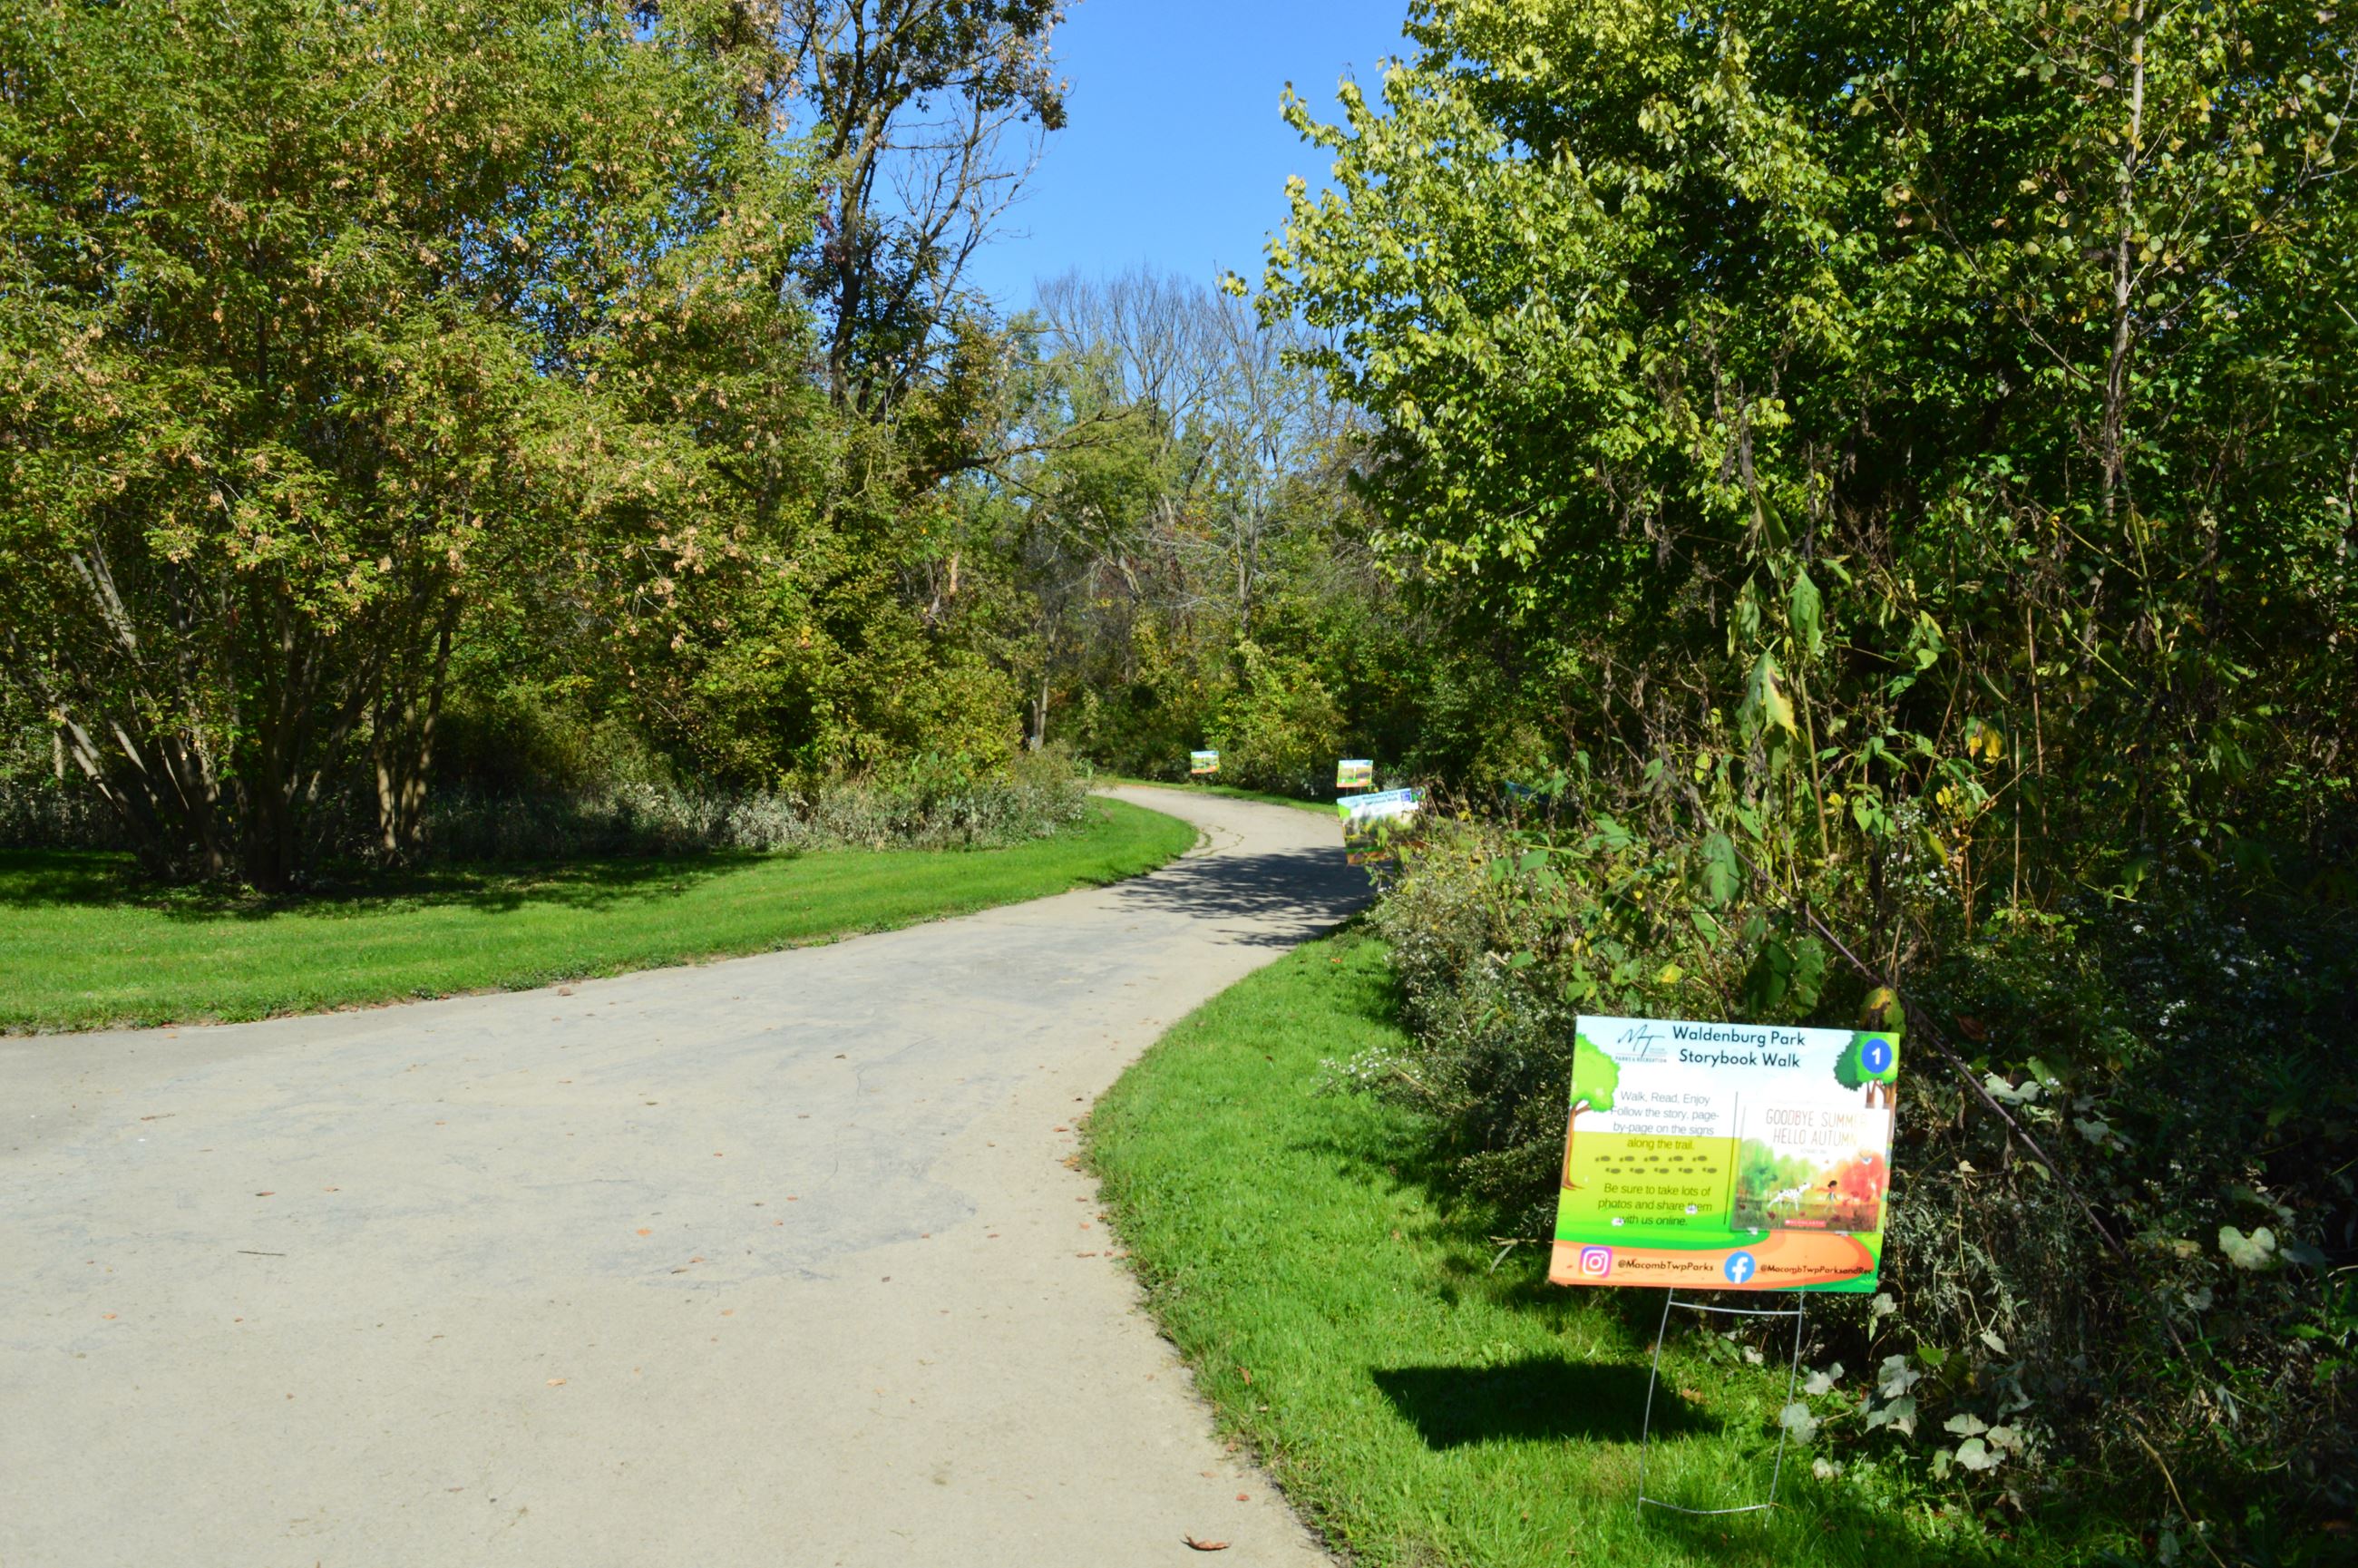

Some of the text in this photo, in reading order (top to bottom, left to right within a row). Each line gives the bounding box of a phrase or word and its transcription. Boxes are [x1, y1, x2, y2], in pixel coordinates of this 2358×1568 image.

[1673, 1026, 1806, 1047] Waldenburg Park
[1679, 1048, 1800, 1067] Storybook Walk
[1872, 1047, 1881, 1065] 1
[1683, 1094, 1710, 1106] Enjoy
[1611, 1105, 1642, 1117] Follow
[1645, 1107, 1661, 1118] the
[1692, 1112, 1720, 1122] page-
[1766, 1108, 1814, 1127] GOODBYE
[1613, 1122, 1714, 1137] by-page on the signs
[1773, 1127, 1857, 1147] HELLO AUTUMN
[1627, 1138, 1695, 1151] along the trail.
[1604, 1183, 1711, 1196] Be sure to take lots of
[1598, 1198, 1632, 1210] photos
[1635, 1199, 1654, 1211] and
[1657, 1200, 1684, 1212] share
[1642, 1216, 1653, 1225] us
[1656, 1215, 1688, 1226] online.
[1618, 1259, 1714, 1272] @MacombTwpParks
